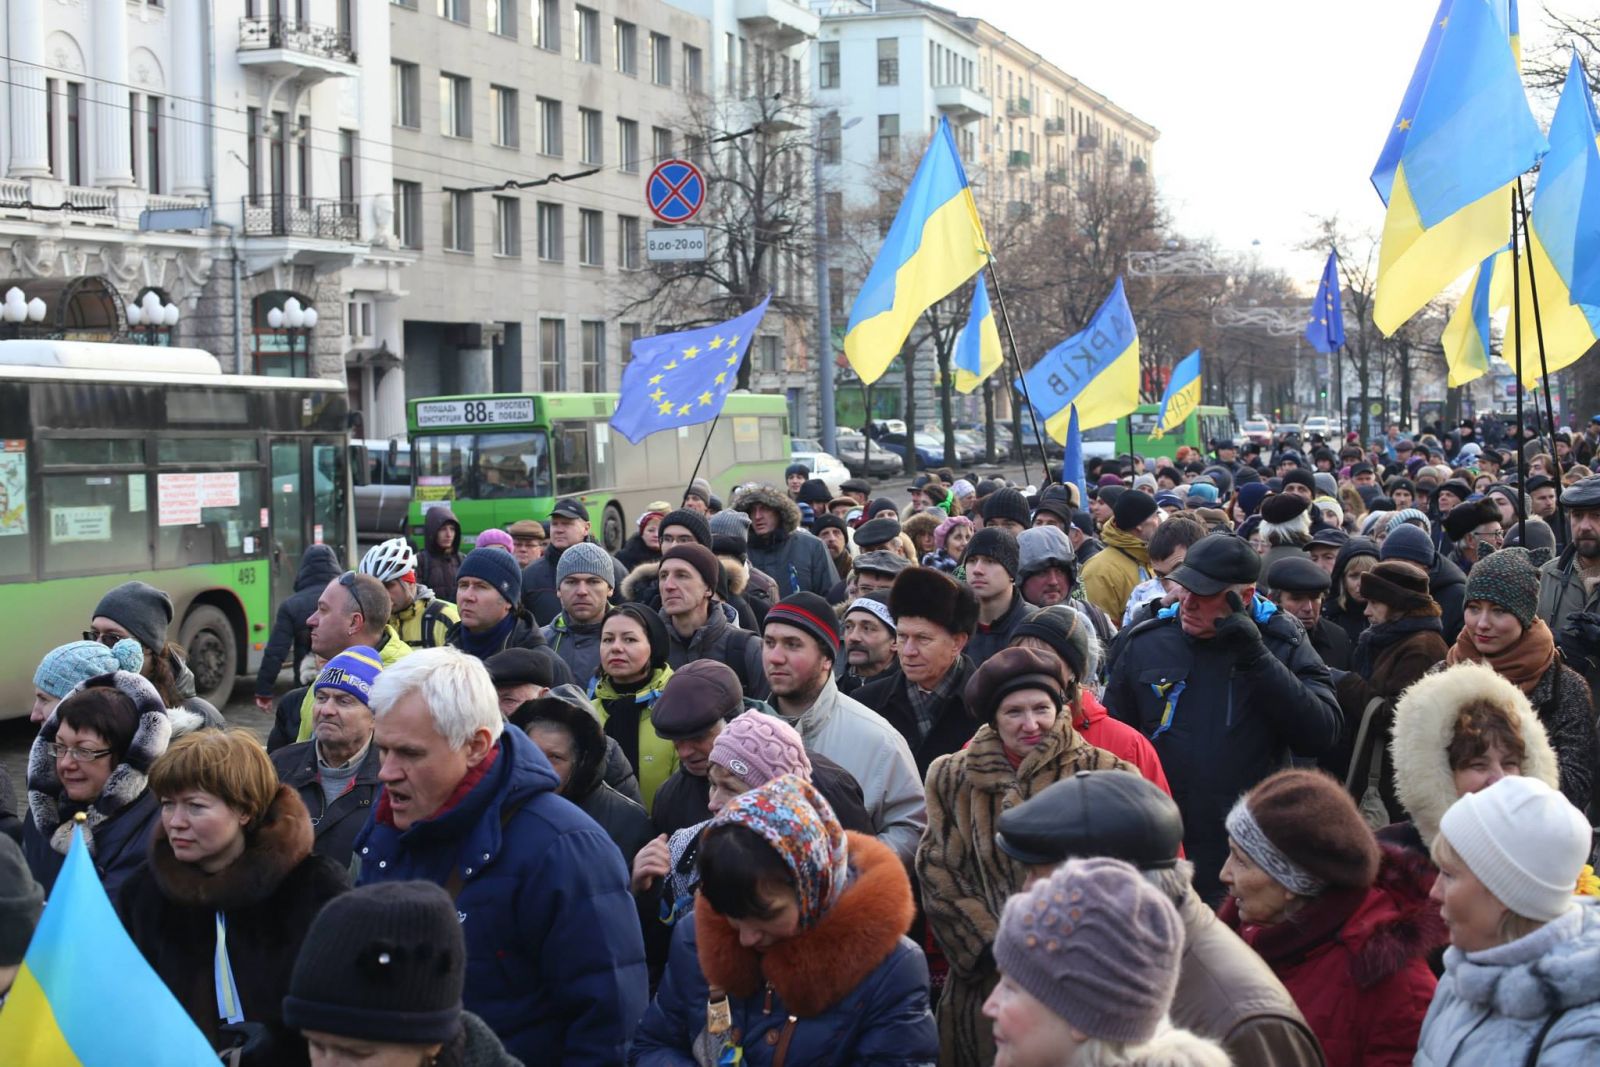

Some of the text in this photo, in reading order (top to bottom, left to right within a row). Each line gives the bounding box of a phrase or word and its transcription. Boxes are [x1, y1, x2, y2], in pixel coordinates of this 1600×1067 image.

[423, 404, 457, 413] ПЛОЩАДЬ
[494, 400, 531, 410] ПРОСПЕКТ
[498, 411, 529, 420] ПОБЕДЫ
[238, 567, 256, 585] 493
